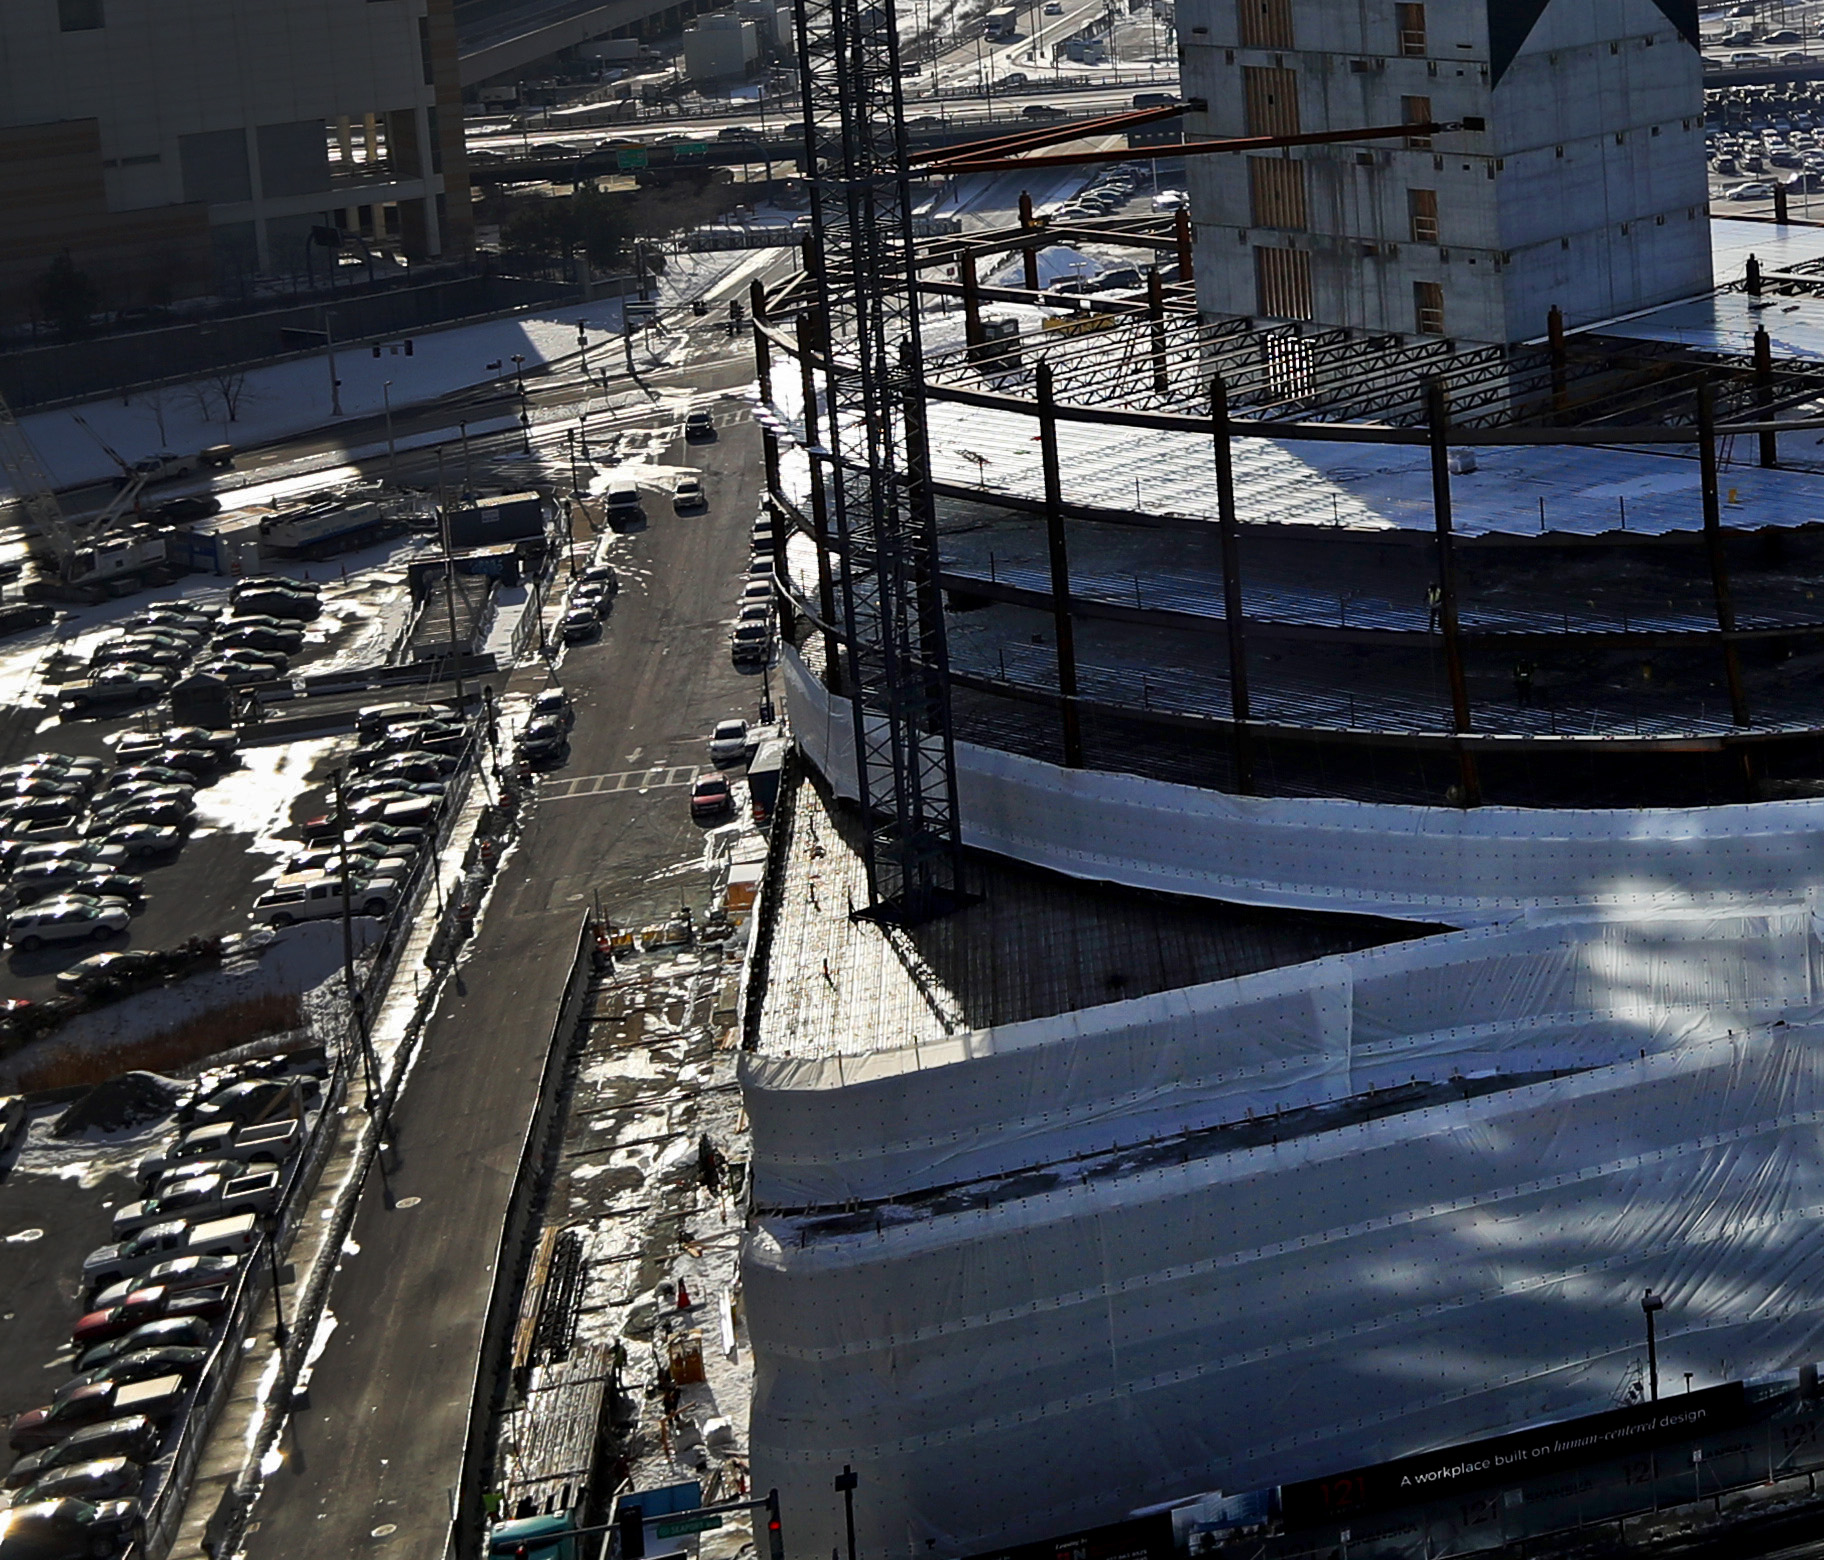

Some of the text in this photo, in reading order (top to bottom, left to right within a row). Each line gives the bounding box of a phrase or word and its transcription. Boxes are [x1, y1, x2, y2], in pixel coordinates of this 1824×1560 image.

[1400, 1407, 1707, 1488] A workplace built on human-centered design
[1320, 1474, 1367, 1512] 121
